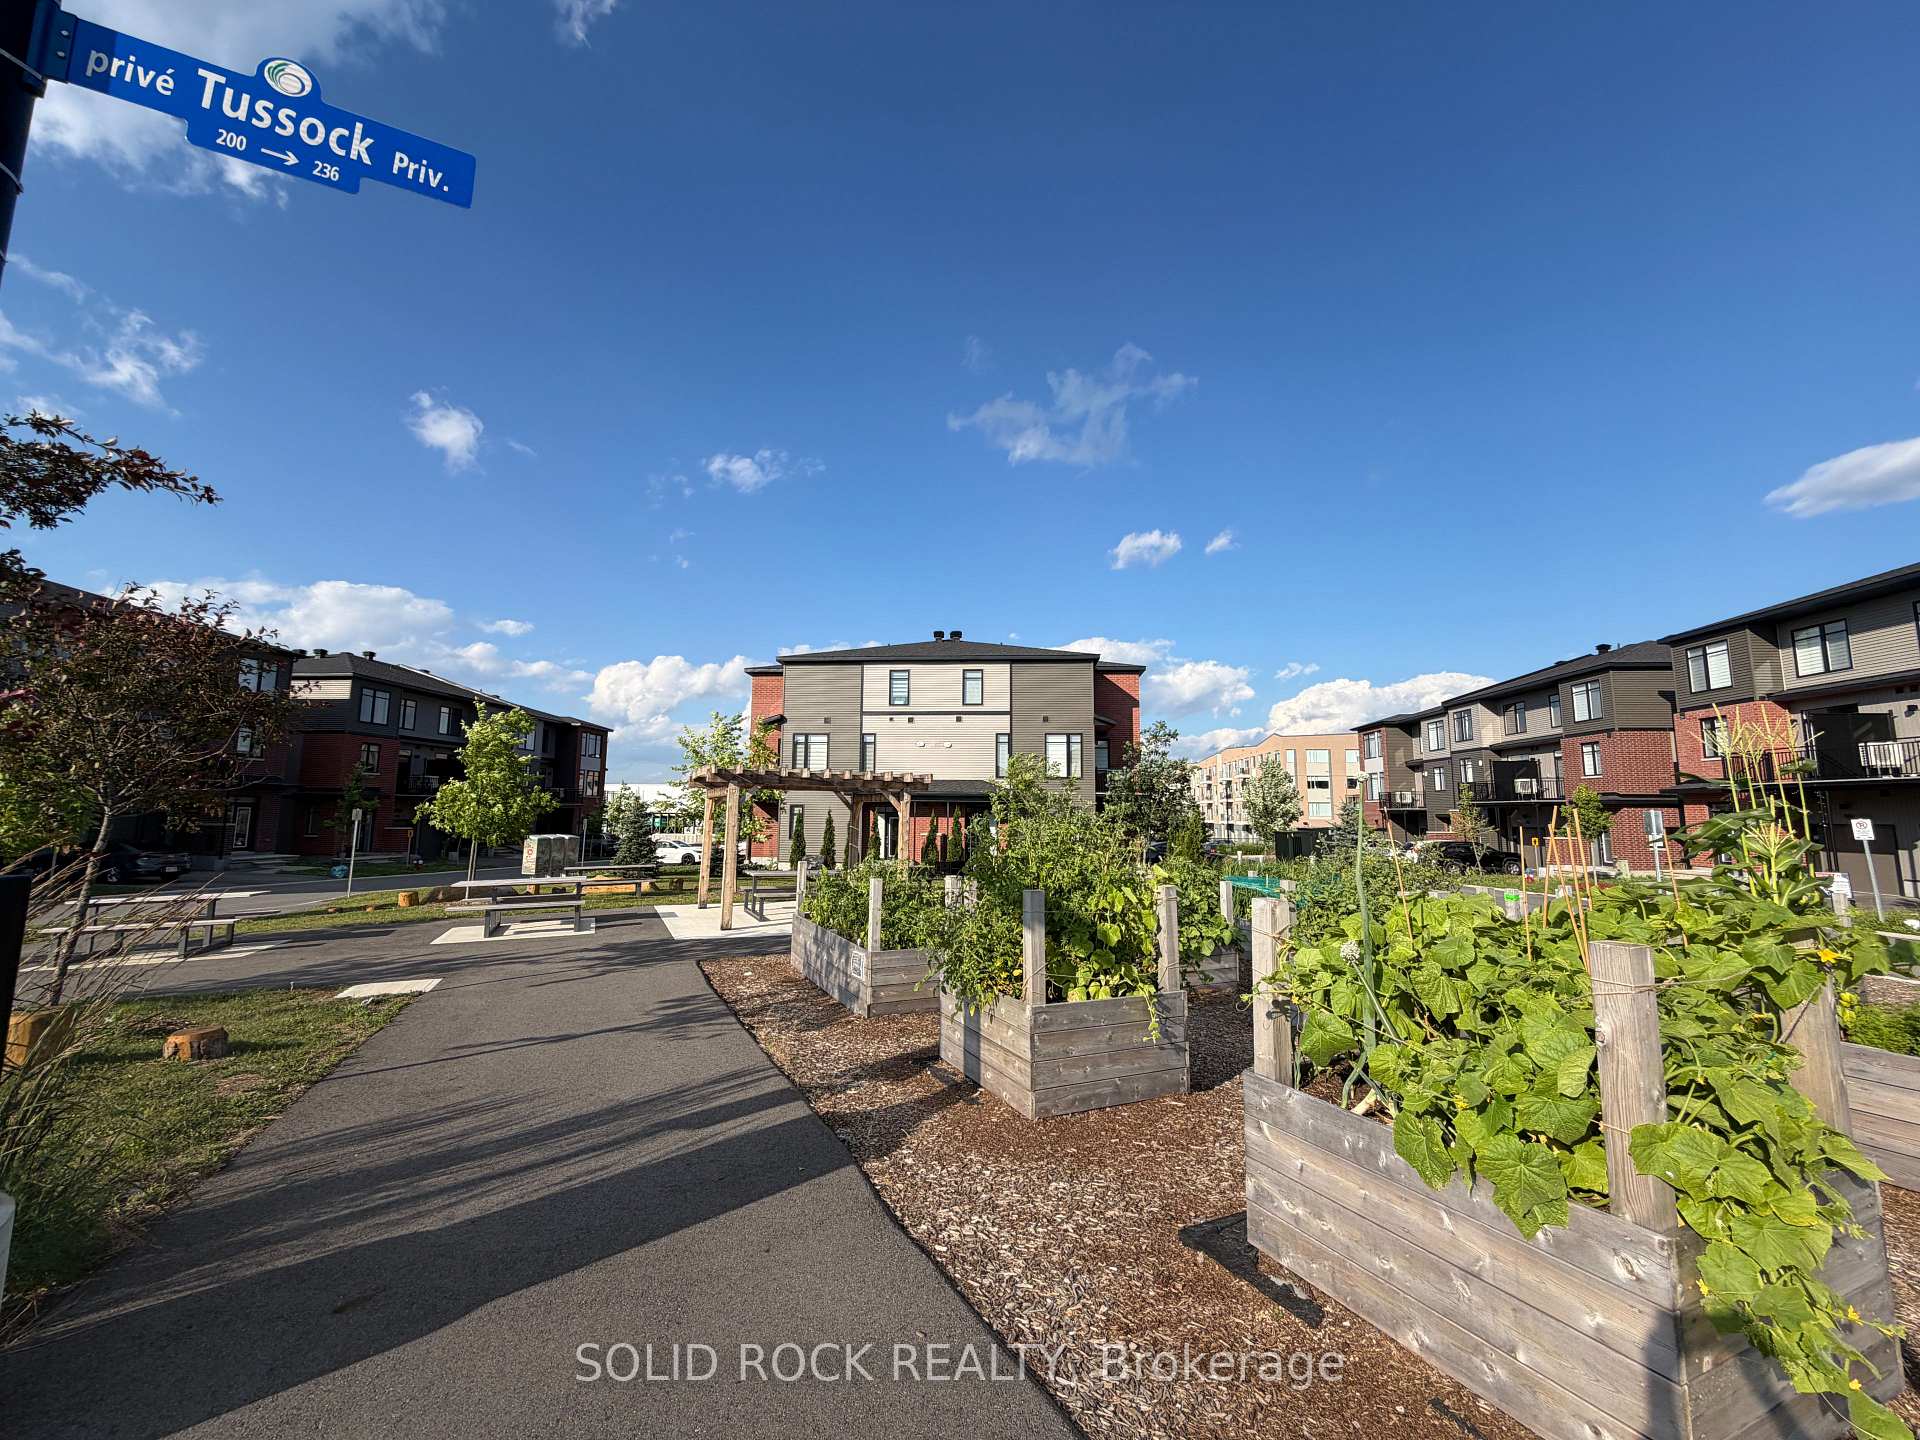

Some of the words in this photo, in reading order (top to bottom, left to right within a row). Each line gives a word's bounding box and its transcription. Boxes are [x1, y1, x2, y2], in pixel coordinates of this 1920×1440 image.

[85, 49, 176, 96] privé
[197, 68, 375, 166] Tussock
[392, 151, 449, 192] Priv.
[215, 128, 247, 151] 200
[312, 160, 340, 182] 236
